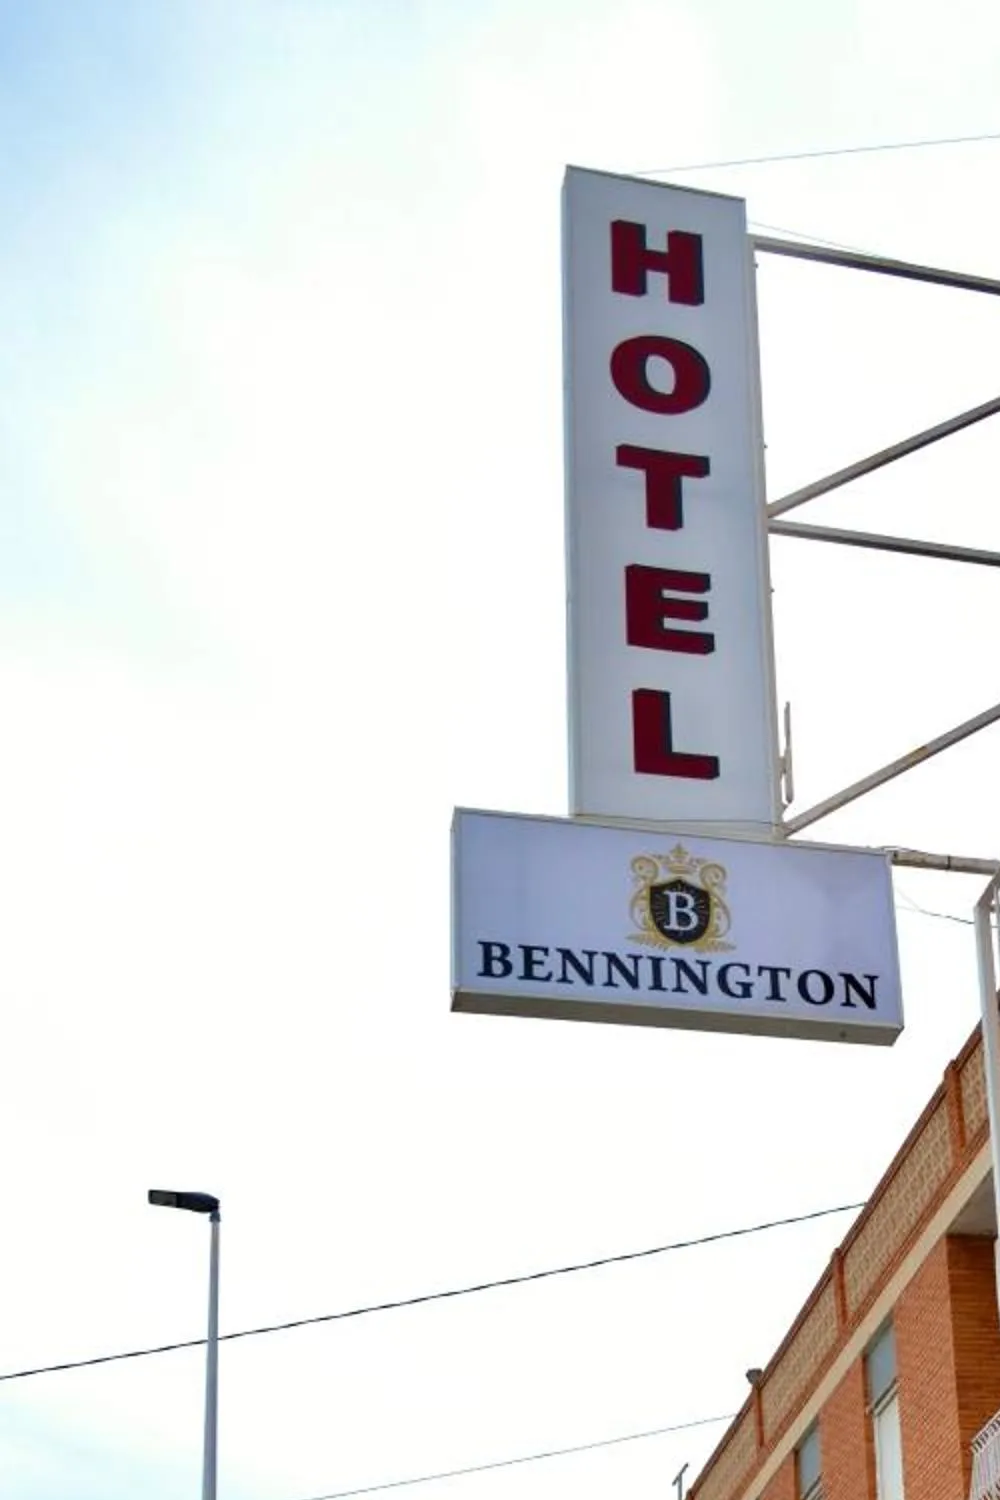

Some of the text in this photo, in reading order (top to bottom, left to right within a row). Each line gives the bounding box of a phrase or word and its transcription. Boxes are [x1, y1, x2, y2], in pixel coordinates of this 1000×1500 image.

[609, 219, 720, 781] HOTEL
[662, 889, 699, 931] B
[477, 940, 879, 1010] BENNINGTON
